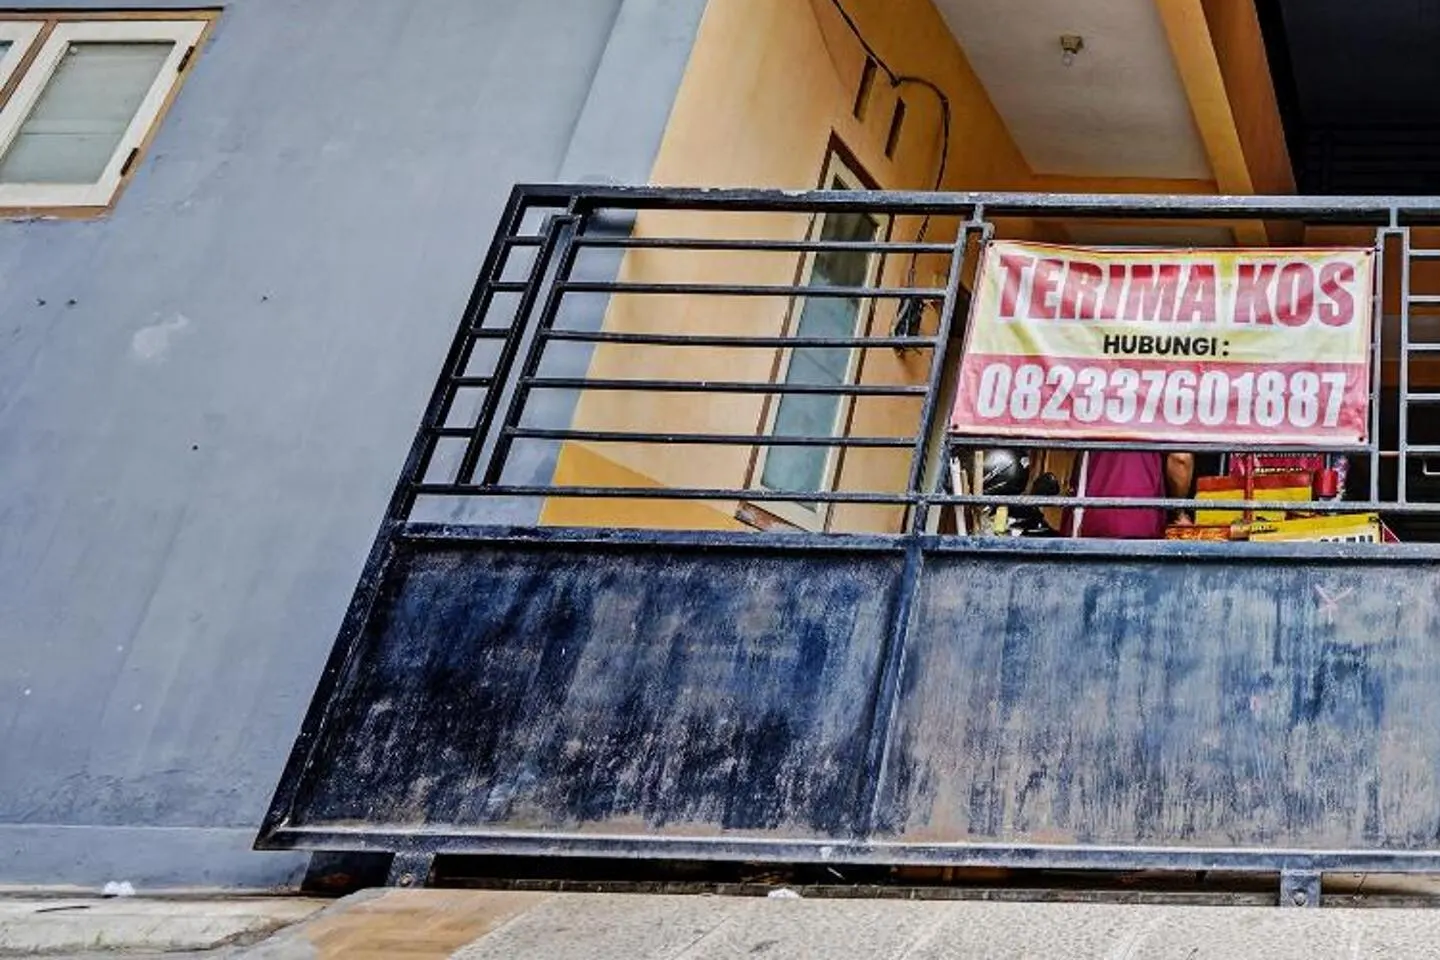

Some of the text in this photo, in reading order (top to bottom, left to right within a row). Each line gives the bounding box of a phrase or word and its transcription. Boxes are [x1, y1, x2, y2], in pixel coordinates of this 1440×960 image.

[999, 255, 1355, 327] TERIMA KOS
[976, 363, 1348, 429] 082337601887
